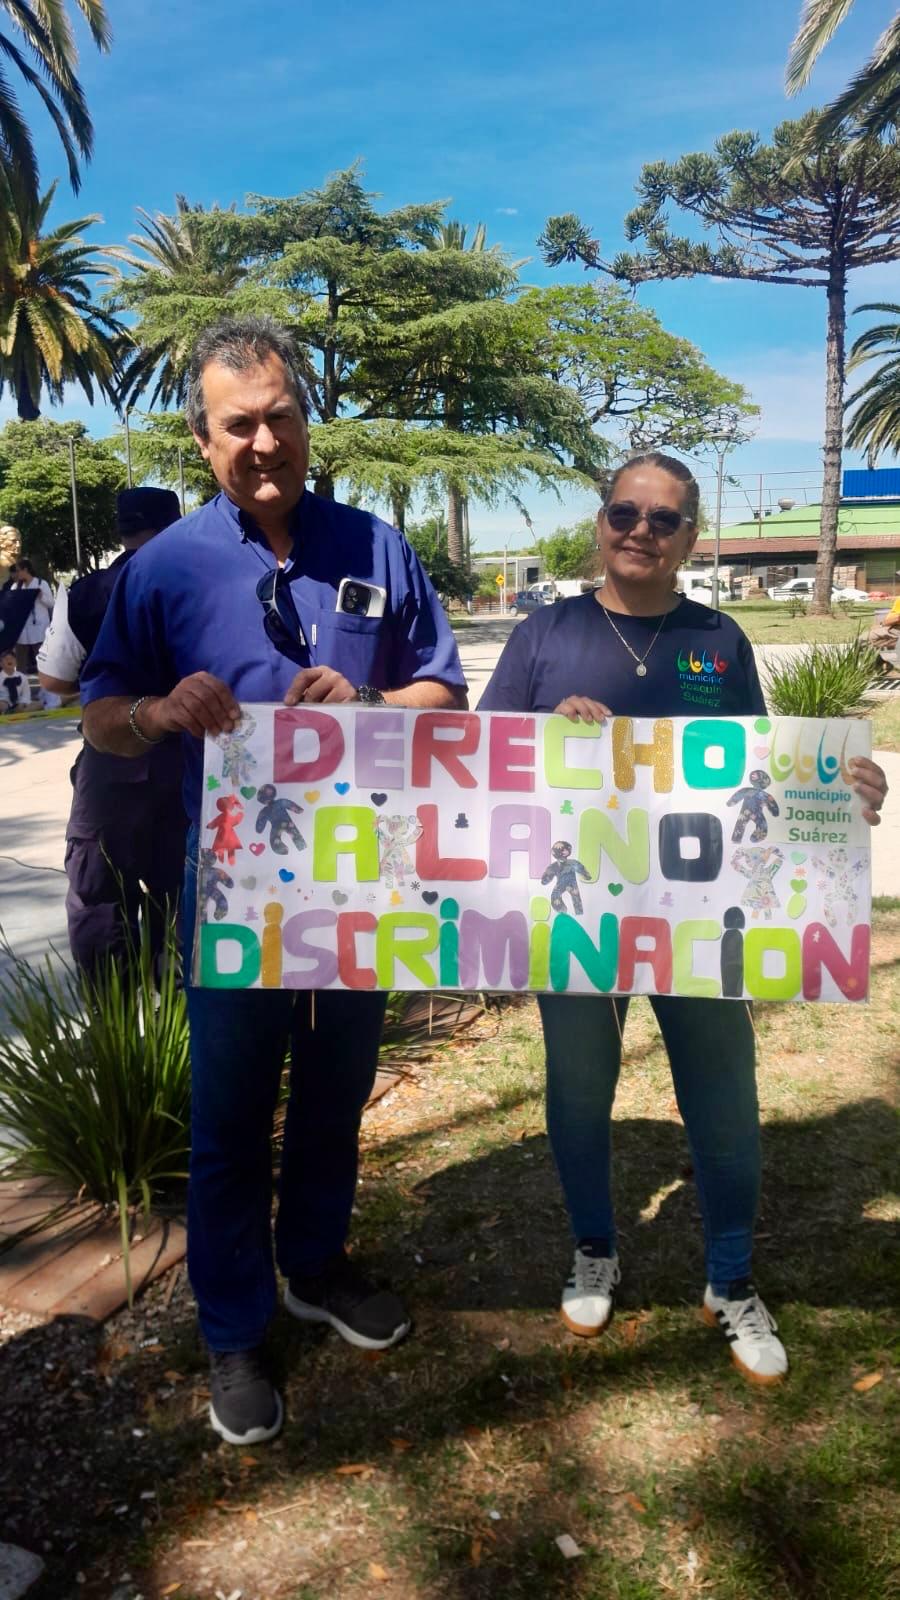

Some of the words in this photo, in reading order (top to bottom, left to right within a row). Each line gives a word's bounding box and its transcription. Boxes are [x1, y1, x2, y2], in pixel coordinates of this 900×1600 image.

[272, 708, 747, 793] DERECHO
[784, 789, 851, 804] municipio
[785, 806, 851, 824] Joaquín
[312, 805, 380, 882] A
[416, 804, 551, 881] LA
[579, 807, 723, 885] NO
[789, 828, 848, 844] Suárez
